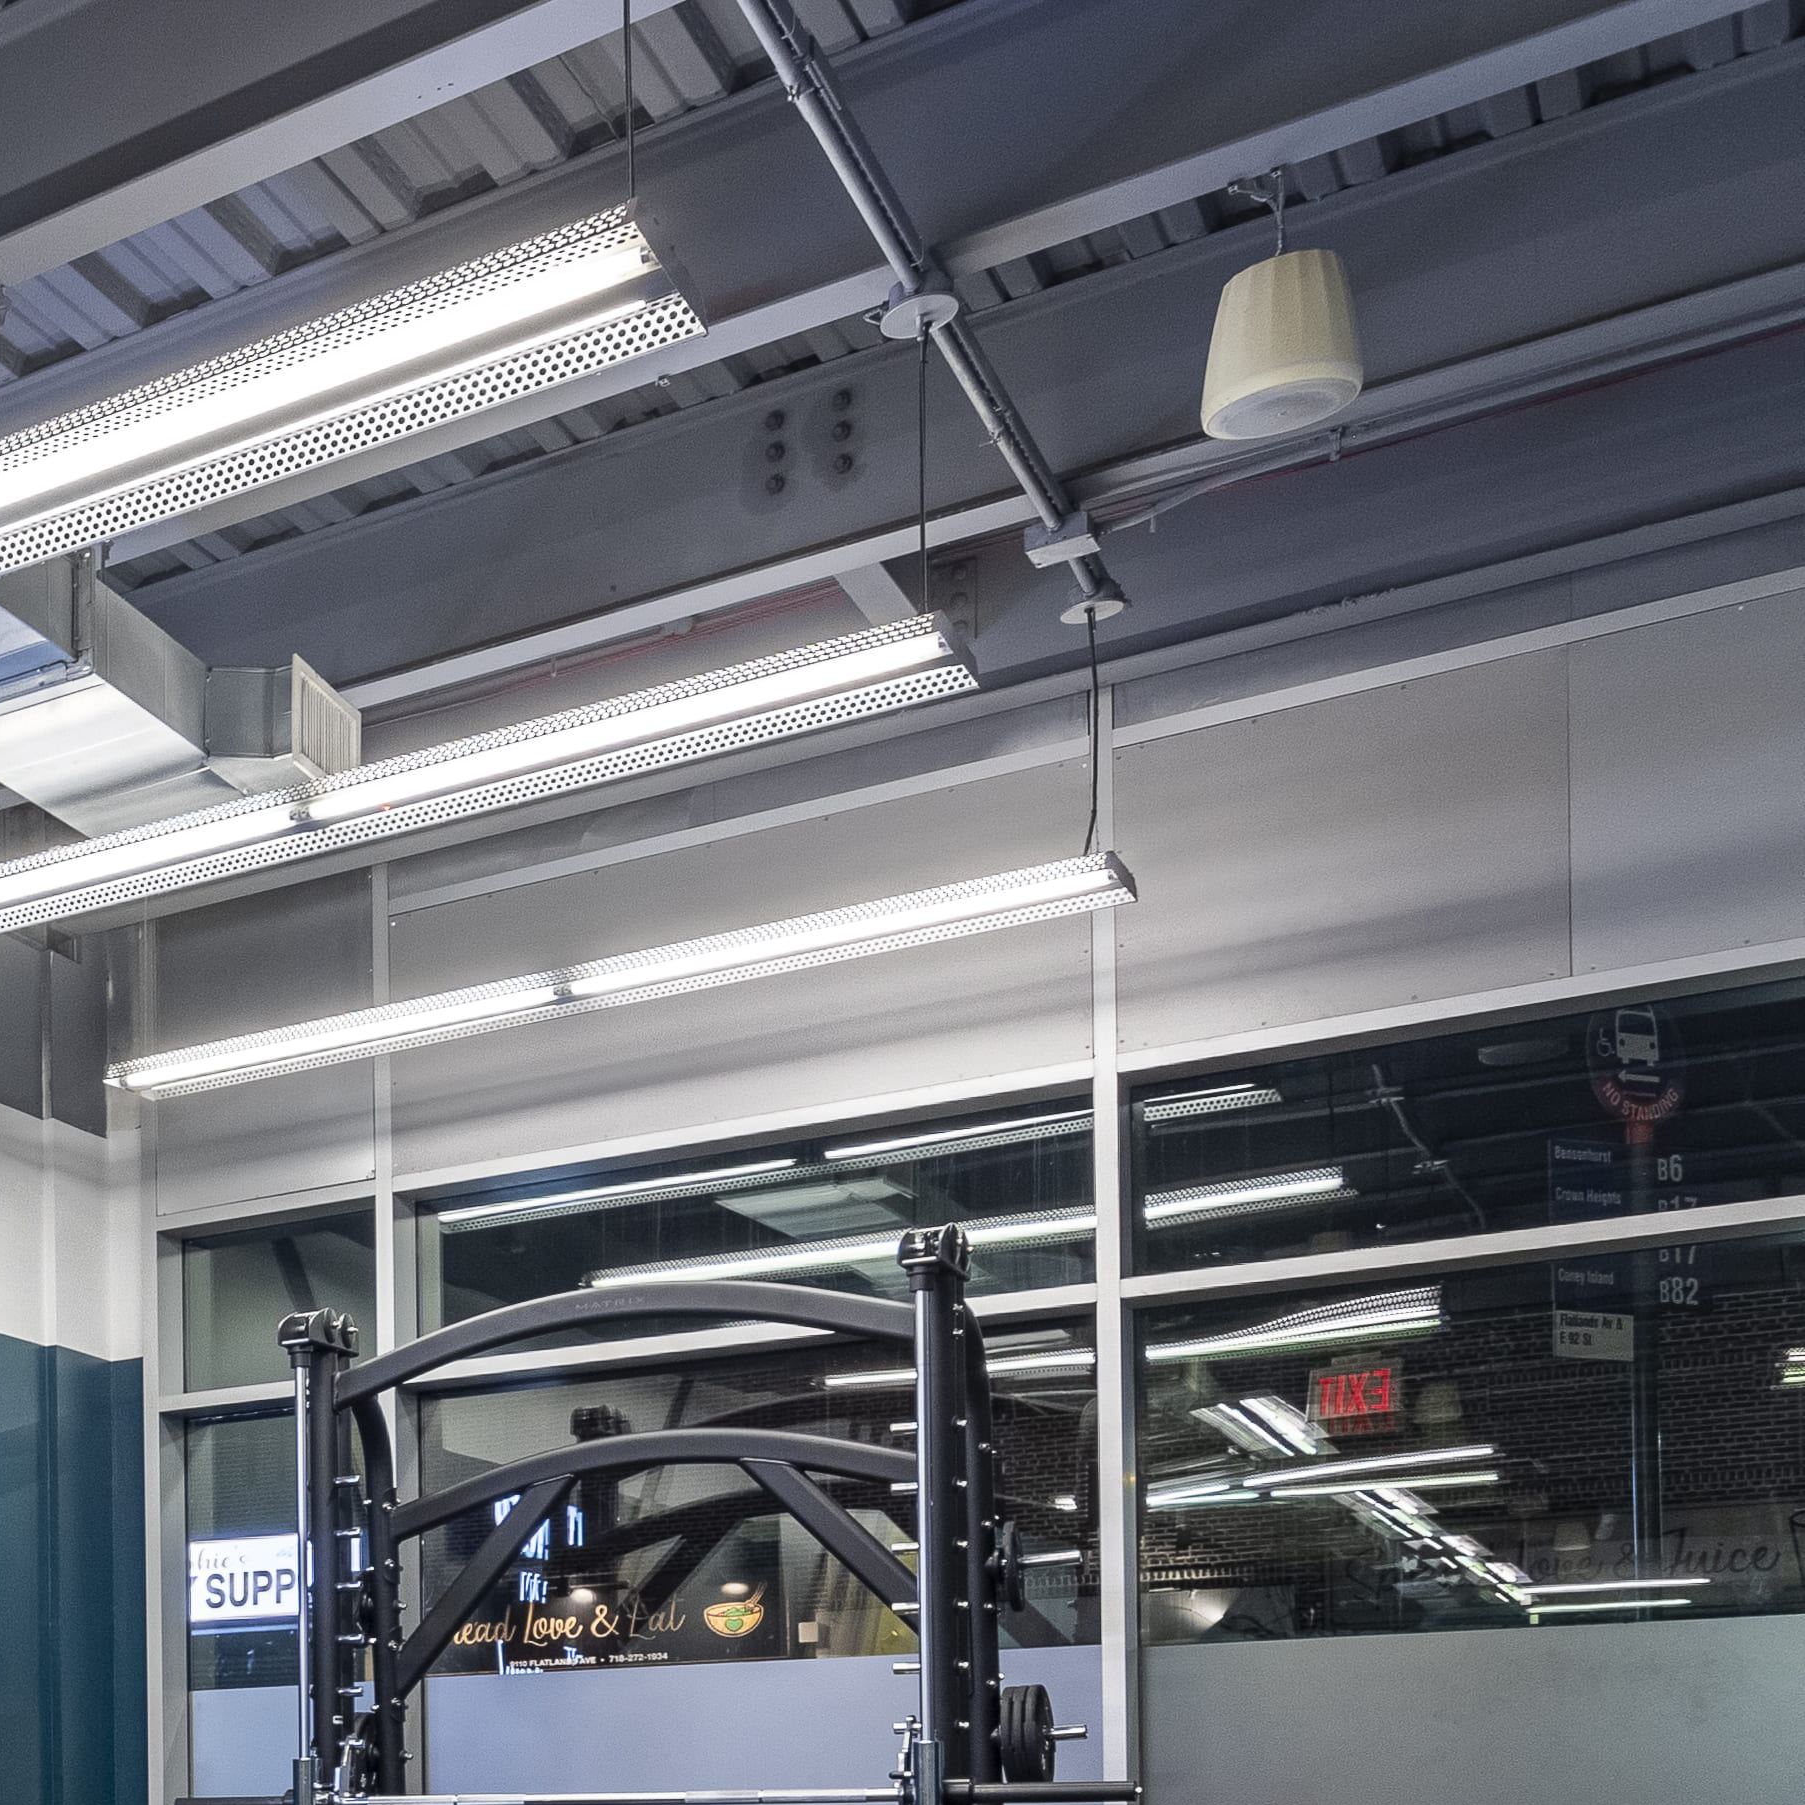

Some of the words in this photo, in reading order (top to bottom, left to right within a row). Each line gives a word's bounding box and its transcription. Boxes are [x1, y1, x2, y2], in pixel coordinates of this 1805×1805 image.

[1603, 1081, 1621, 1106] NO
[1621, 1088, 1679, 1120] STANDING
[1657, 1154, 1683, 1182] B6
[1555, 1186, 1584, 1201] Crown
[1586, 1188, 1622, 1206] Heights
[1558, 1268, 1585, 1286] Coney
[1587, 1270, 1614, 1285] Island
[1659, 1277, 1699, 1306] B82
[1560, 1331, 1566, 1344] E
[1568, 1331, 1580, 1345] 92
[1661, 1527, 1782, 1576] Juice
[523, 1600, 583, 1647] Love
[591, 1604, 620, 1639] &
